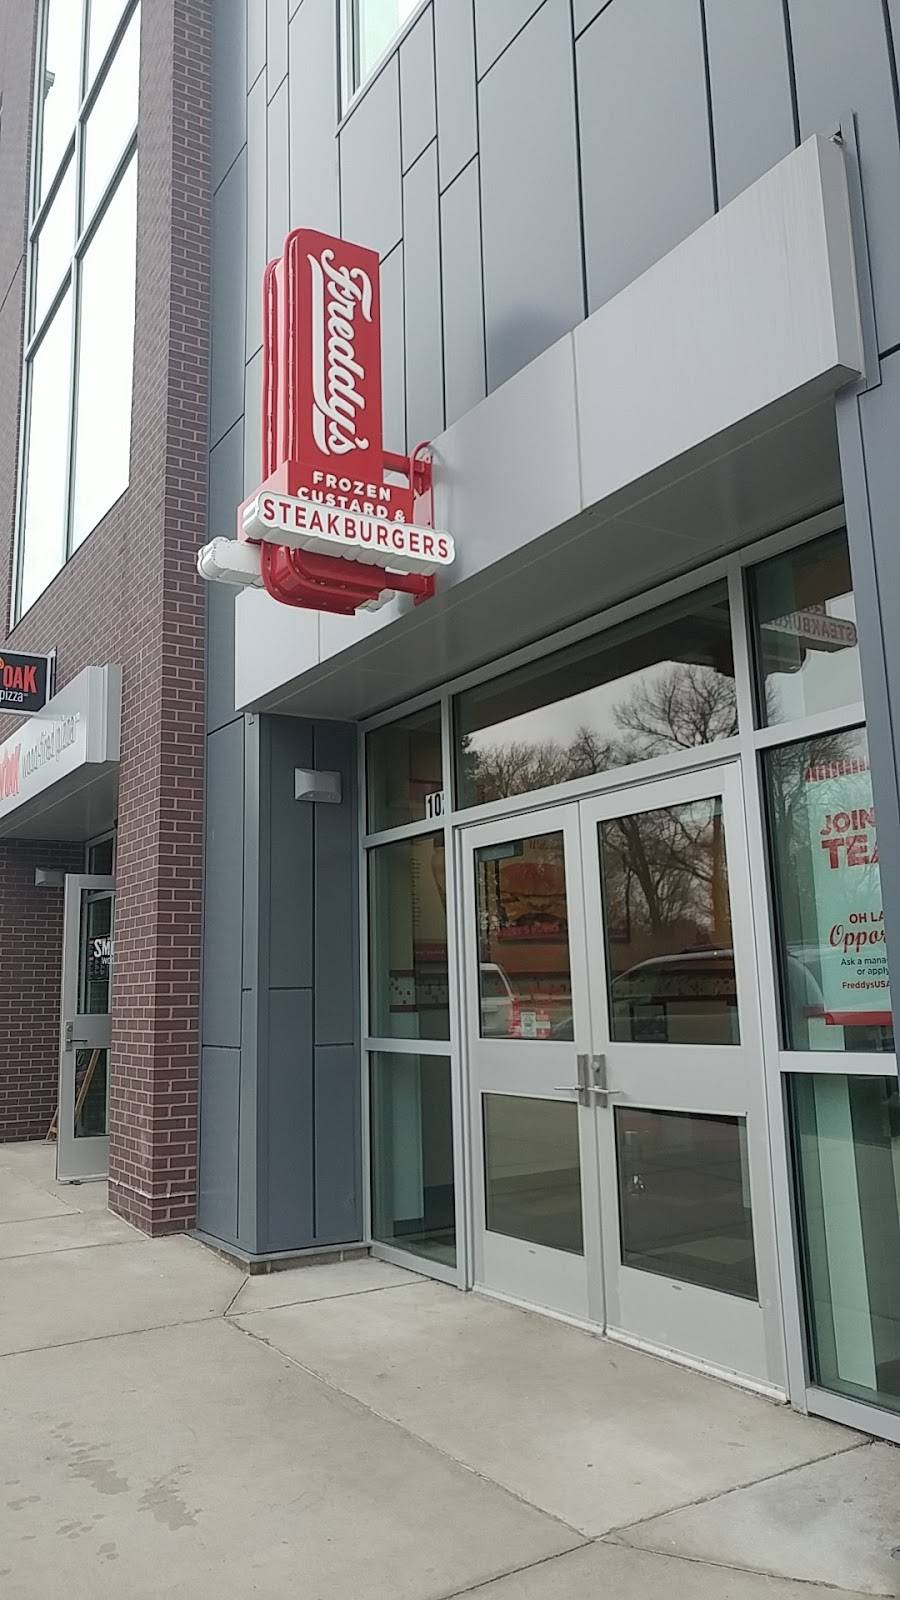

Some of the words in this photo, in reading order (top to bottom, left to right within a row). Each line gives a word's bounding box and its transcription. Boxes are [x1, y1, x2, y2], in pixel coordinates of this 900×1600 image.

[307, 249, 372, 456] Freddy's
[312, 470, 391, 502] FROZEN
[297, 486, 388, 519] CUSTARD
[394, 509, 406, 523] &
[263, 499, 449, 558] STEAKBURGERS
[3, 665, 37, 693] OAK
[0, 688, 24, 703] pizza
[428, 793, 445, 818] 10
[820, 808, 876, 835] JOIN
[849, 912, 867, 924] OH
[840, 957, 856, 966] Ask
[856, 968, 865, 976] or
